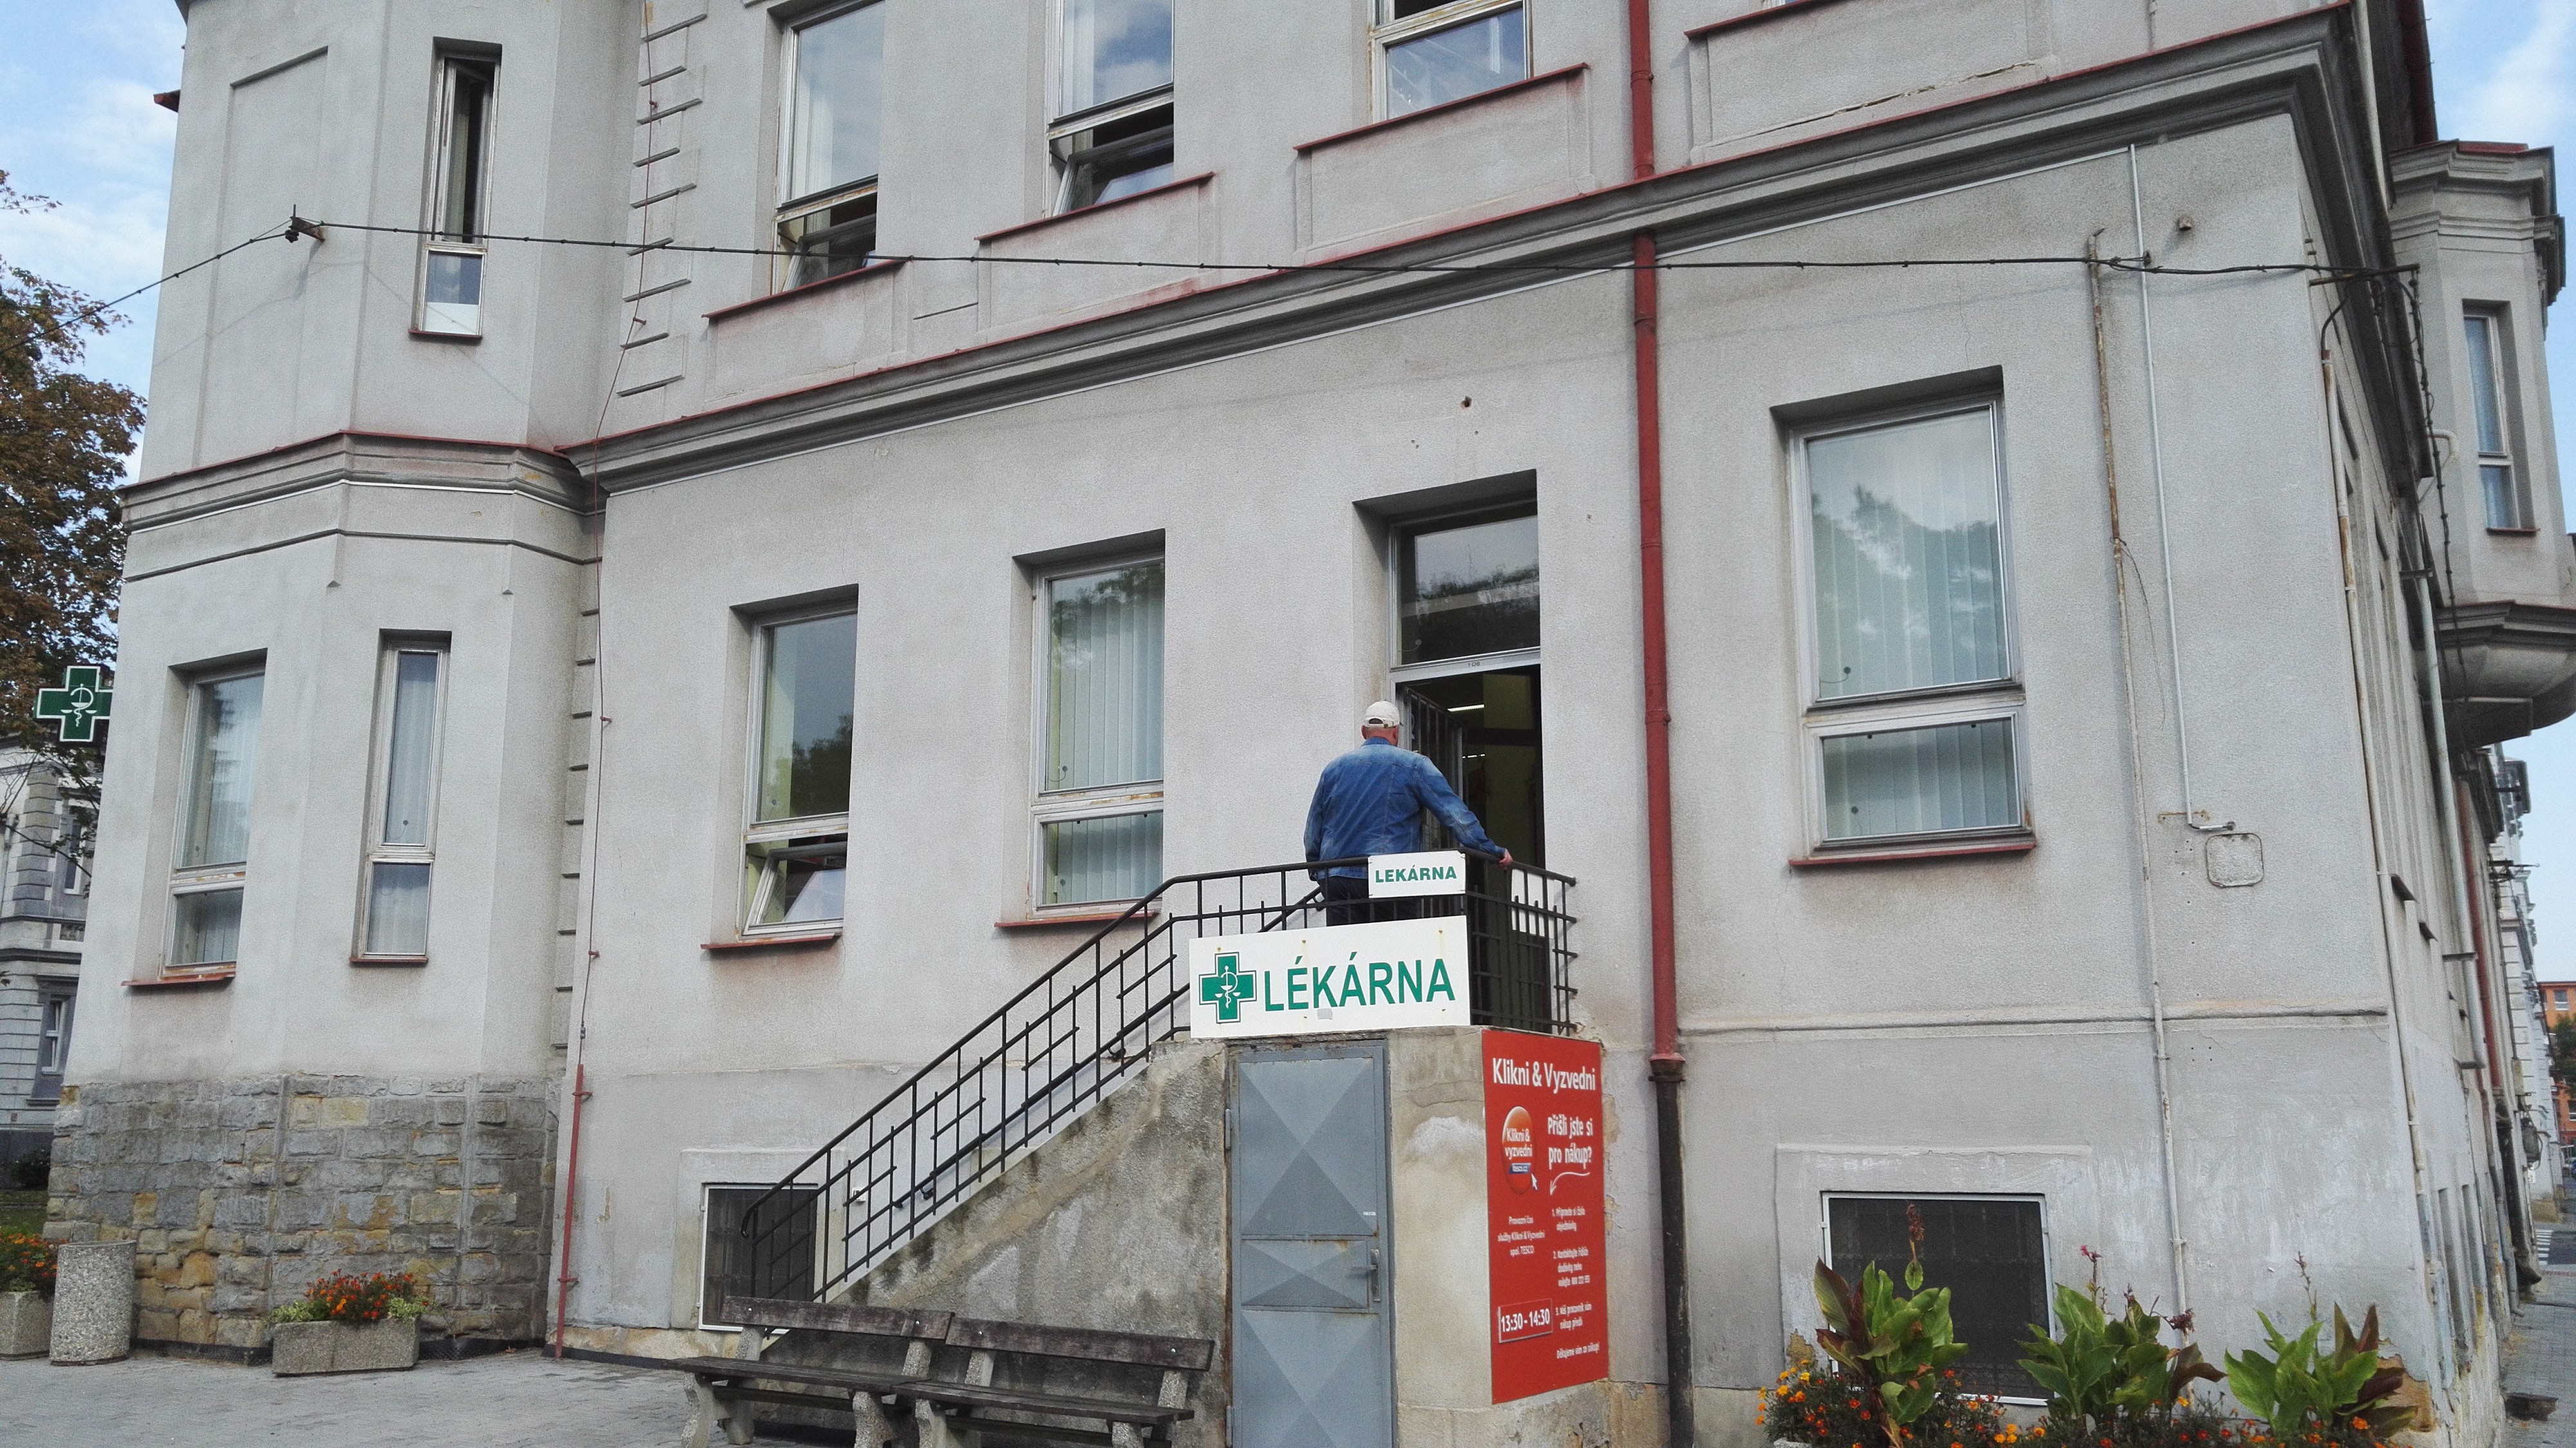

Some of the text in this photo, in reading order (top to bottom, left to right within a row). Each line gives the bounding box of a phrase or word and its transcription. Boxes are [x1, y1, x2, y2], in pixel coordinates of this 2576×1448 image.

[1376, 864, 1457, 883] LEKÁRNA
[1264, 951, 1455, 1011] LÉKÁRNA
[1493, 1058, 1596, 1094] Klikni & Vyzvedni
[1506, 1128, 1530, 1142] Klikni &
[1548, 1114, 1593, 1139] Přišli jste si
[1505, 1143, 1533, 1160] vyzvedni
[1548, 1142, 1592, 1170] pro nákup?
[1501, 1313, 1523, 1333] 13:30
[1529, 1308, 1550, 1327] 14:30
